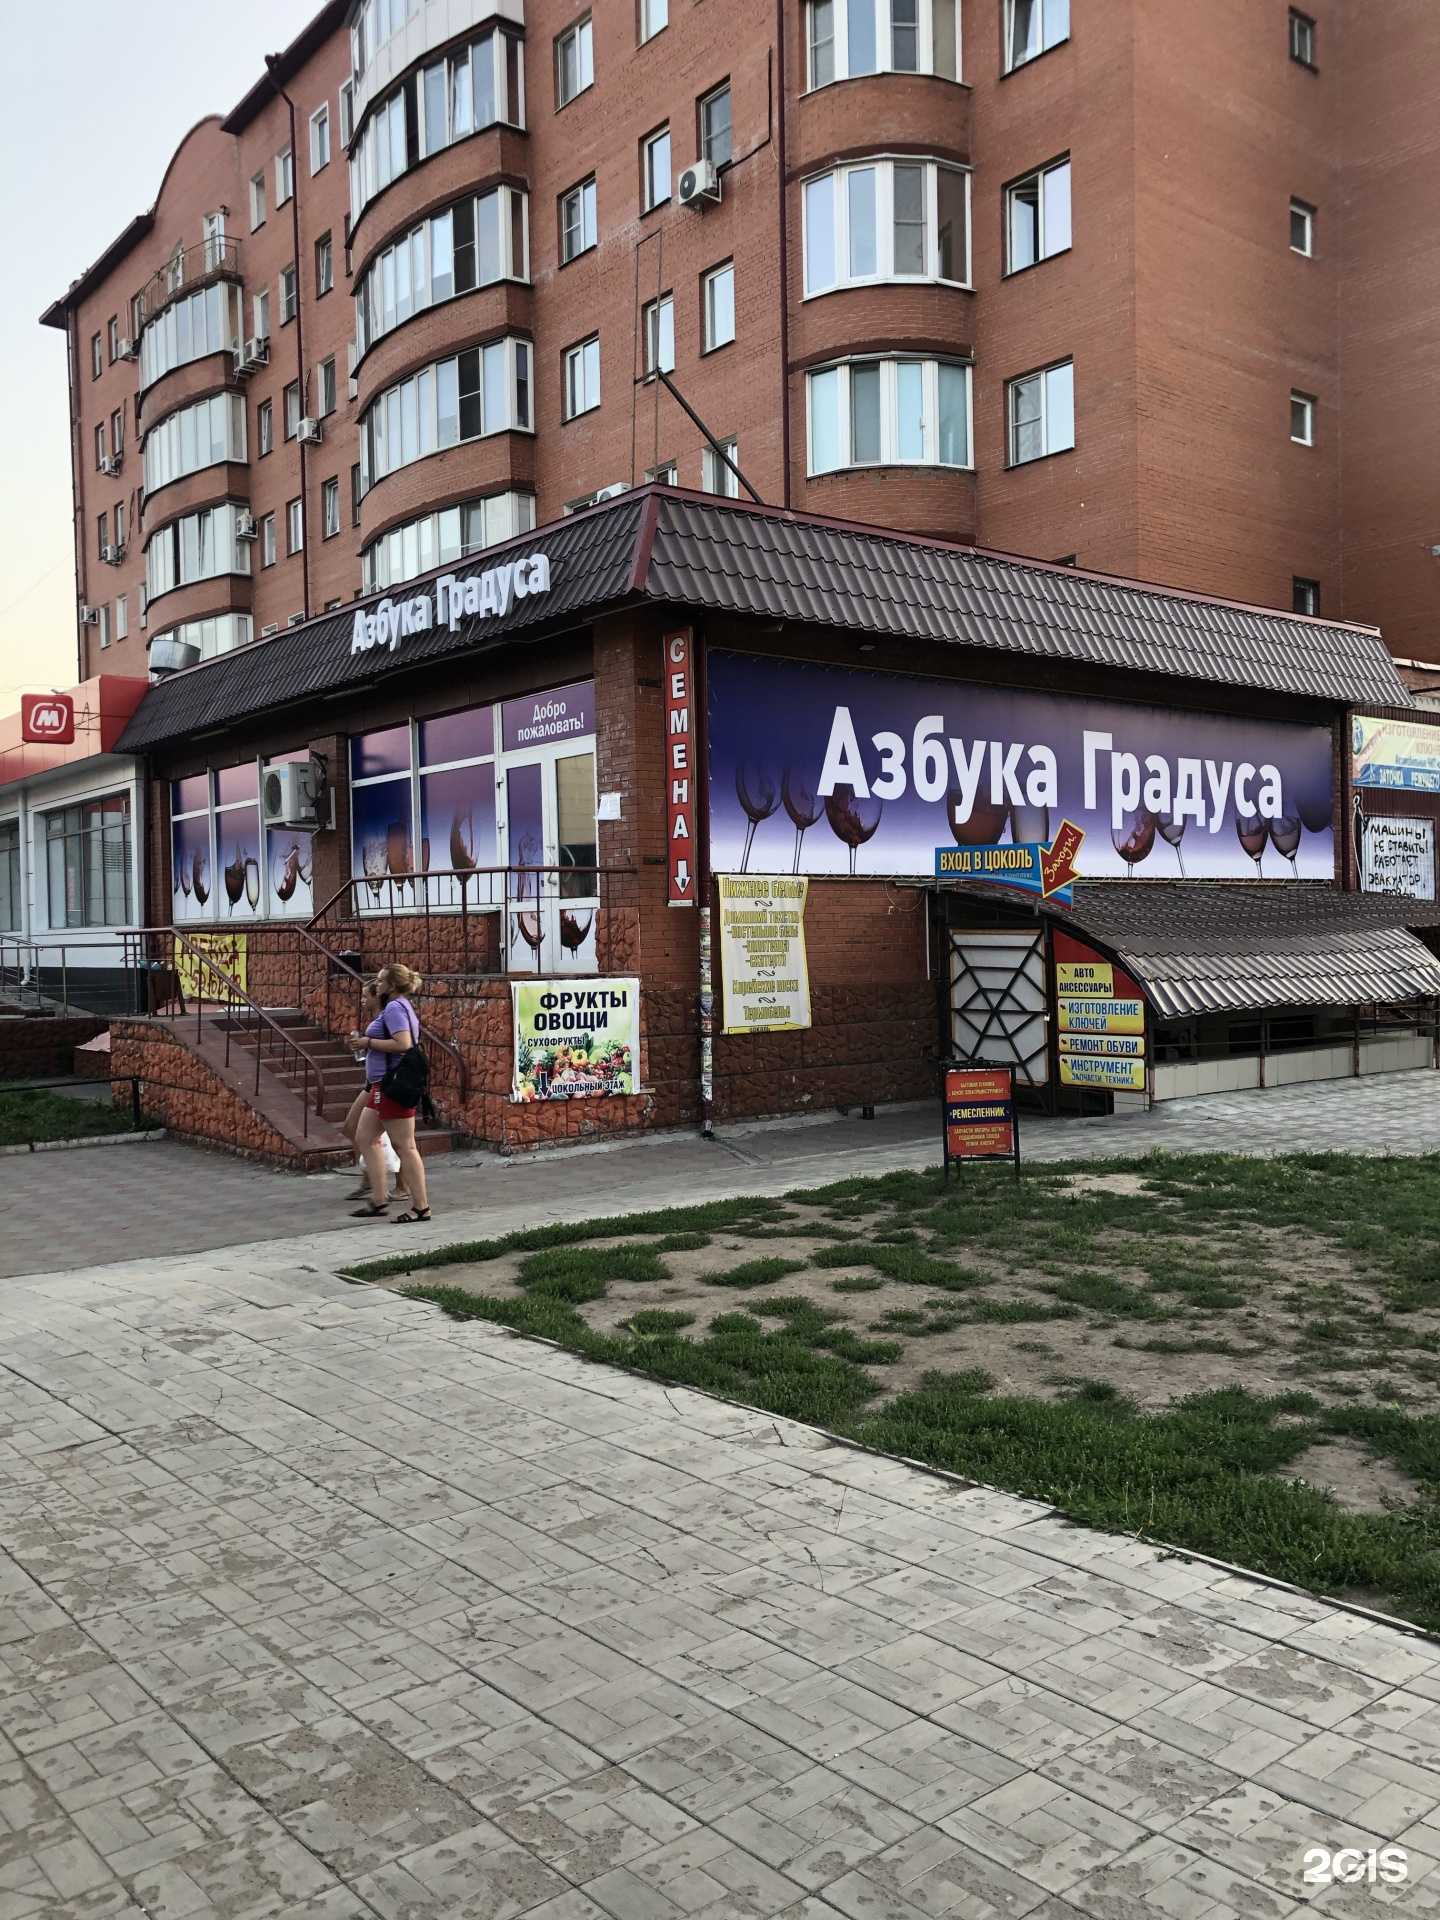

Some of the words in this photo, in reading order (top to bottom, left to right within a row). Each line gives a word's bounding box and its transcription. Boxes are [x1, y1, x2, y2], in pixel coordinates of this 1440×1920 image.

[351, 598, 432, 655] Азбука
[436, 553, 550, 632] Градуса
[533, 700, 567, 724] Добро
[518, 712, 584, 741] пожаловать!
[670, 637, 689, 839] СЕМЕНА
[817, 706, 1058, 824] Азбука
[1083, 730, 1283, 833] Градуса
[1370, 824, 1426, 840] МАШИНЫ
[940, 852, 971, 872] ВХОД
[974, 852, 982, 870] В
[984, 849, 1033, 872] ЦОКОЛЬ
[1044, 828, 1077, 882] Заходи!
[1374, 855, 1419, 869] РАБОТАЕТ
[1074, 968, 1094, 978] АВТО
[1059, 982, 1111, 993] АКСЕССУАРЫ
[540, 991, 627, 1010] ФРУКТЫ
[1068, 1002, 1138, 1016] ИЗГОТОВЛЕНИЕ
[534, 1011, 608, 1031] ОВОЩИ
[1068, 1016, 1107, 1030] КЛЮЧЕЙ
[527, 1036, 585, 1047] СУХОФРУКТЫ
[1070, 1038, 1105, 1052] РЕМОНТ
[1107, 1040, 1138, 1053] ОБУВИ
[1071, 1058, 1134, 1074] ИНСТРУМЕНТ
[552, 1082, 603, 1094] ЦОКОЛЬНЫЙ
[604, 1080, 624, 1090] ЭТАЖ
[1105, 1075, 1134, 1085] ТЕХНИКА
[952, 1107, 1005, 1119] РЕМЕСЛЕННИК
